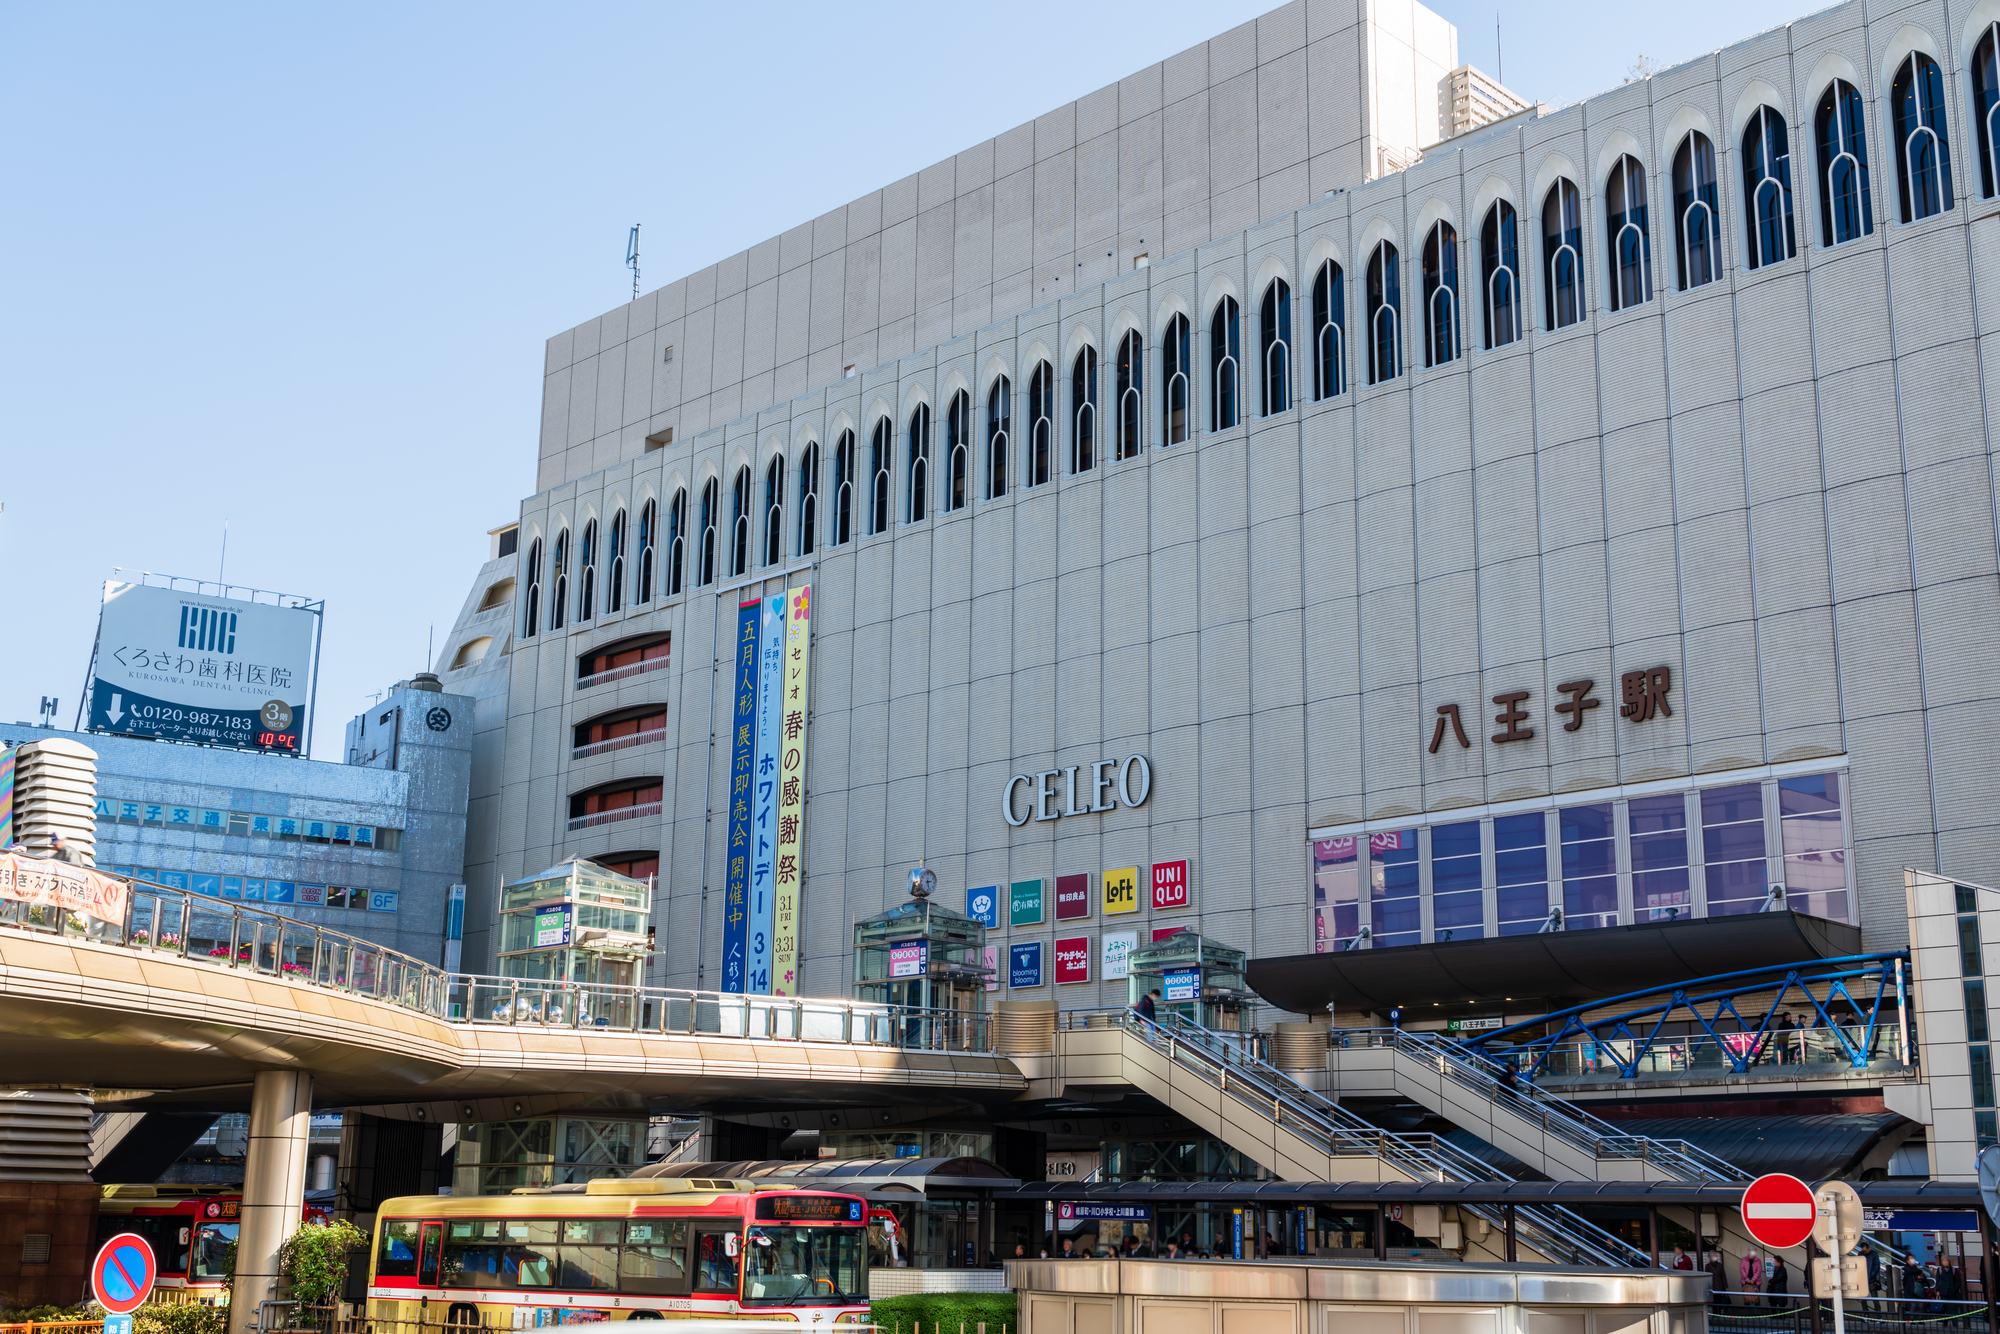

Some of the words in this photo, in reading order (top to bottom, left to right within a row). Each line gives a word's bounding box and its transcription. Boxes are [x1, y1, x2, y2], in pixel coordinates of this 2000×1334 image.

[113, 645, 292, 689] くろさわ歯科医院
[739, 619, 756, 717] 五月人形
[790, 647, 802, 700] セレオ
[128, 670, 185, 685] KUROSAWA
[192, 679, 233, 692] DENTAL
[240, 686, 274, 697] CLINIC
[143, 706, 252, 730] 0120-987-183
[1428, 666, 1672, 754] 八王子駅
[128, 718, 251, 741] 右下エレベーターよりお越しください
[268, 720, 285, 728] 当ビル
[732, 723, 751, 848] 展示即売会
[1002, 754, 1151, 826] CELEO
[778, 710, 803, 886] 春の感謝祭
[94, 800, 220, 827] 八王子交通
[253, 815, 373, 843] 乗務員募集
[754, 752, 774, 914] ホワイトデー
[1156, 866, 1180, 884] UNI
[301, 887, 322, 896] AEON
[302, 894, 320, 902] KIDS
[728, 855, 744, 932] 開催中
[1058, 891, 1086, 902] 無印良品
[1156, 884, 1184, 904] QLO
[373, 894, 392, 908] 6F
[780, 894, 792, 912] 3.1
[780, 912, 792, 922] FRI
[972, 912, 991, 922] Keio
[776, 936, 794, 954] 3.31
[1107, 940, 1132, 952] よみうり
[778, 954, 791, 964] SUN
[1012, 968, 1038, 977] blooming
[1462, 1020, 1486, 1028] 八王子駅
[1246, 1211, 1251, 1220] 7
[1395, 1208, 1400, 1218] 7
[1864, 1211, 1894, 1220] 院大学
[669, 1300, 691, 1309] A10705
